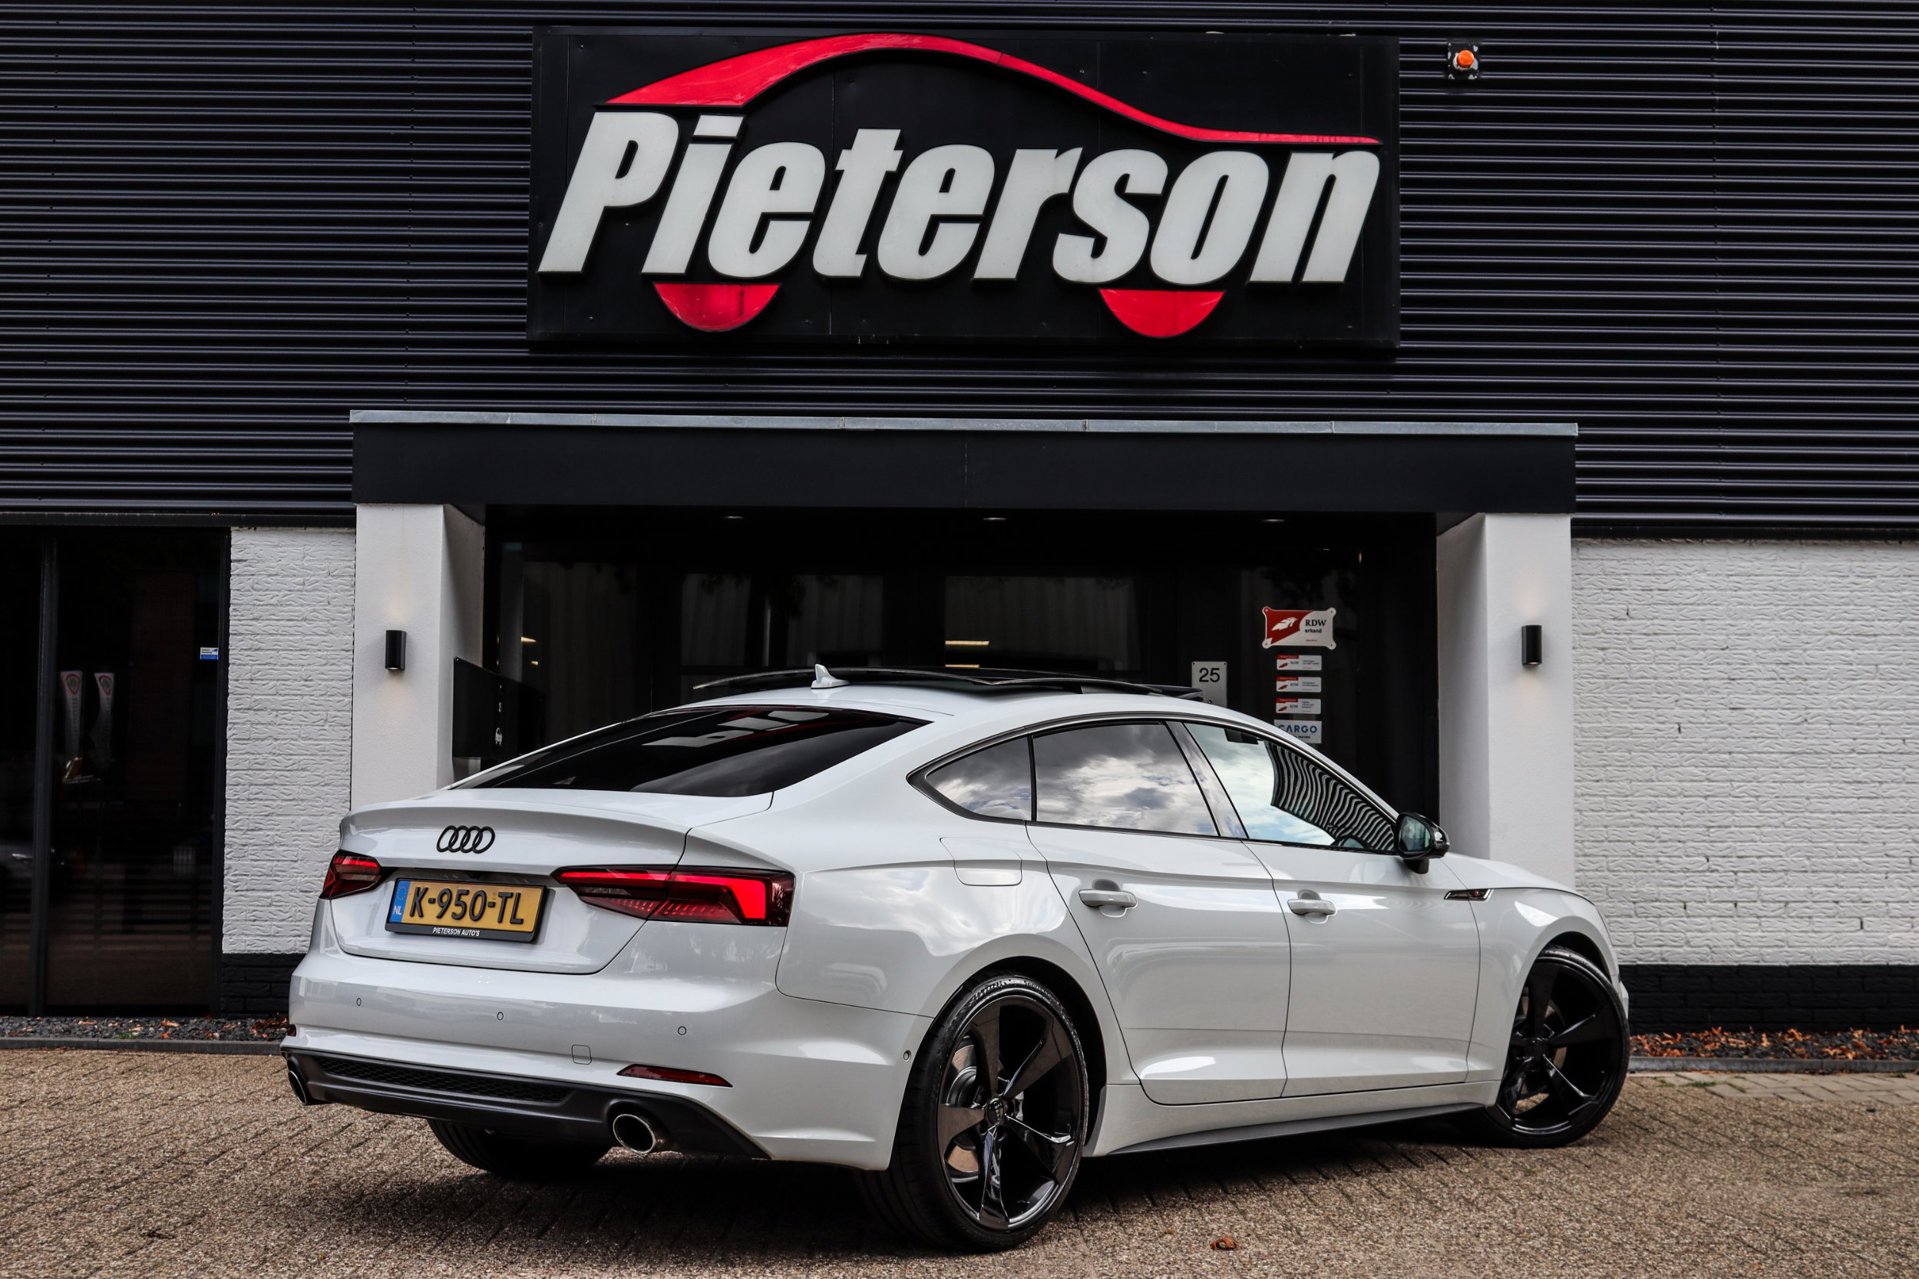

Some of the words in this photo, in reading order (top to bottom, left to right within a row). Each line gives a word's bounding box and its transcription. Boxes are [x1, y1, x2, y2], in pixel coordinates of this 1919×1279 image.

[537, 112, 1380, 284] Pieterson
[1305, 619, 1327, 627] RDW
[1199, 668, 1220, 682] 25
[393, 906, 403, 916] NL
[409, 886, 524, 925] K-950-TL
[432, 927, 461, 936] PIETERSON
[461, 928, 481, 937] AUTO'S
